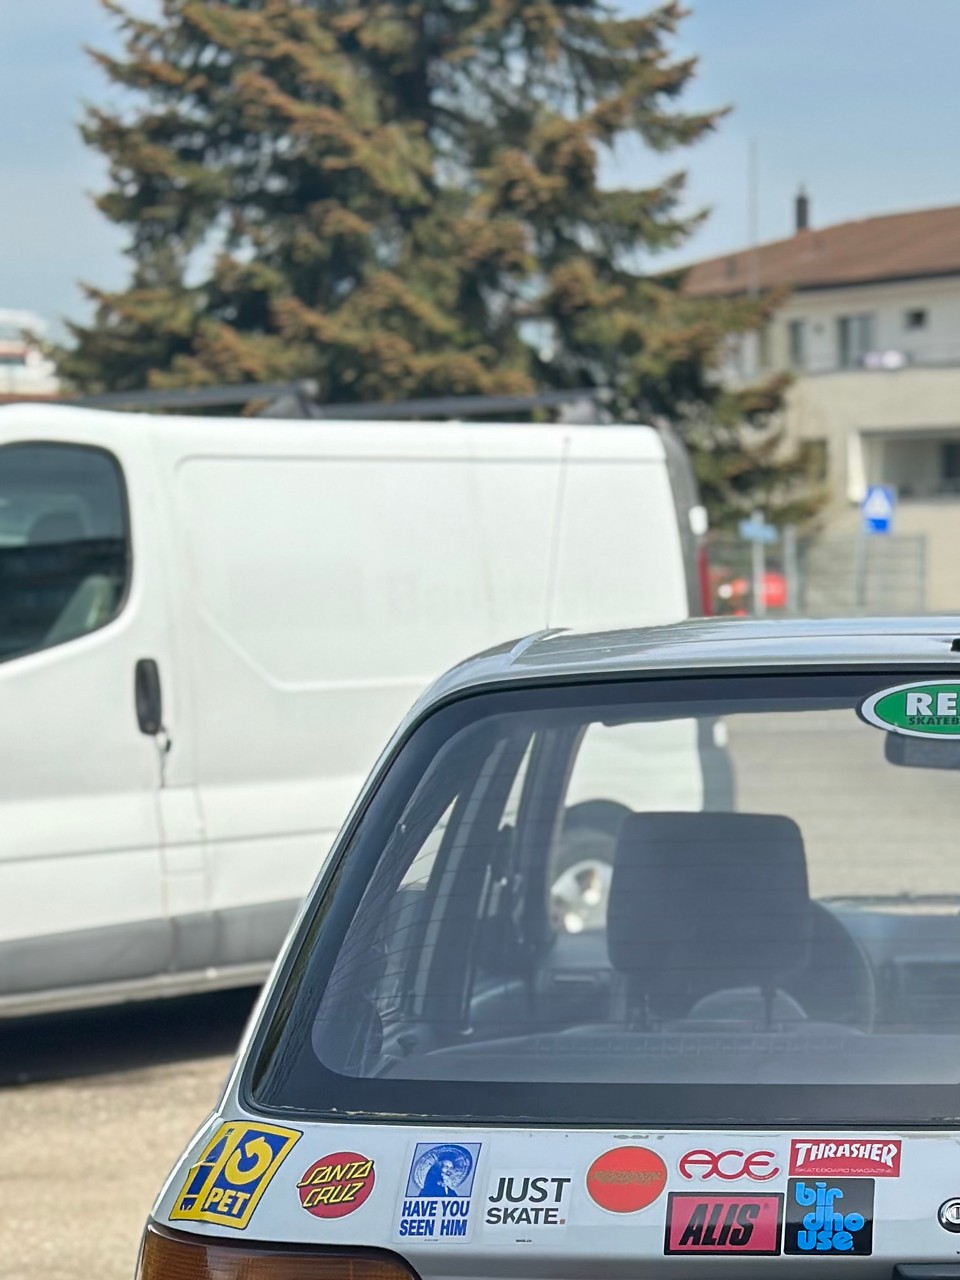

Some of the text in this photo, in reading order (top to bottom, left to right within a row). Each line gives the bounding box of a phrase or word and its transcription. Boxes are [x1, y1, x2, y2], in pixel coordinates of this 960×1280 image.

[679, 1149, 780, 1181] ACE
[795, 1143, 898, 1168] THRASHER
[297, 1160, 374, 1187] SANTA
[204, 1187, 251, 1215] PET
[302, 1182, 365, 1208] CRUZ
[488, 1177, 572, 1203] JUST
[401, 1200, 470, 1217] HAVE YOU
[485, 1207, 566, 1225] SKATE.
[399, 1219, 468, 1236] SEEN HIM
[678, 1203, 761, 1246] ALIS
